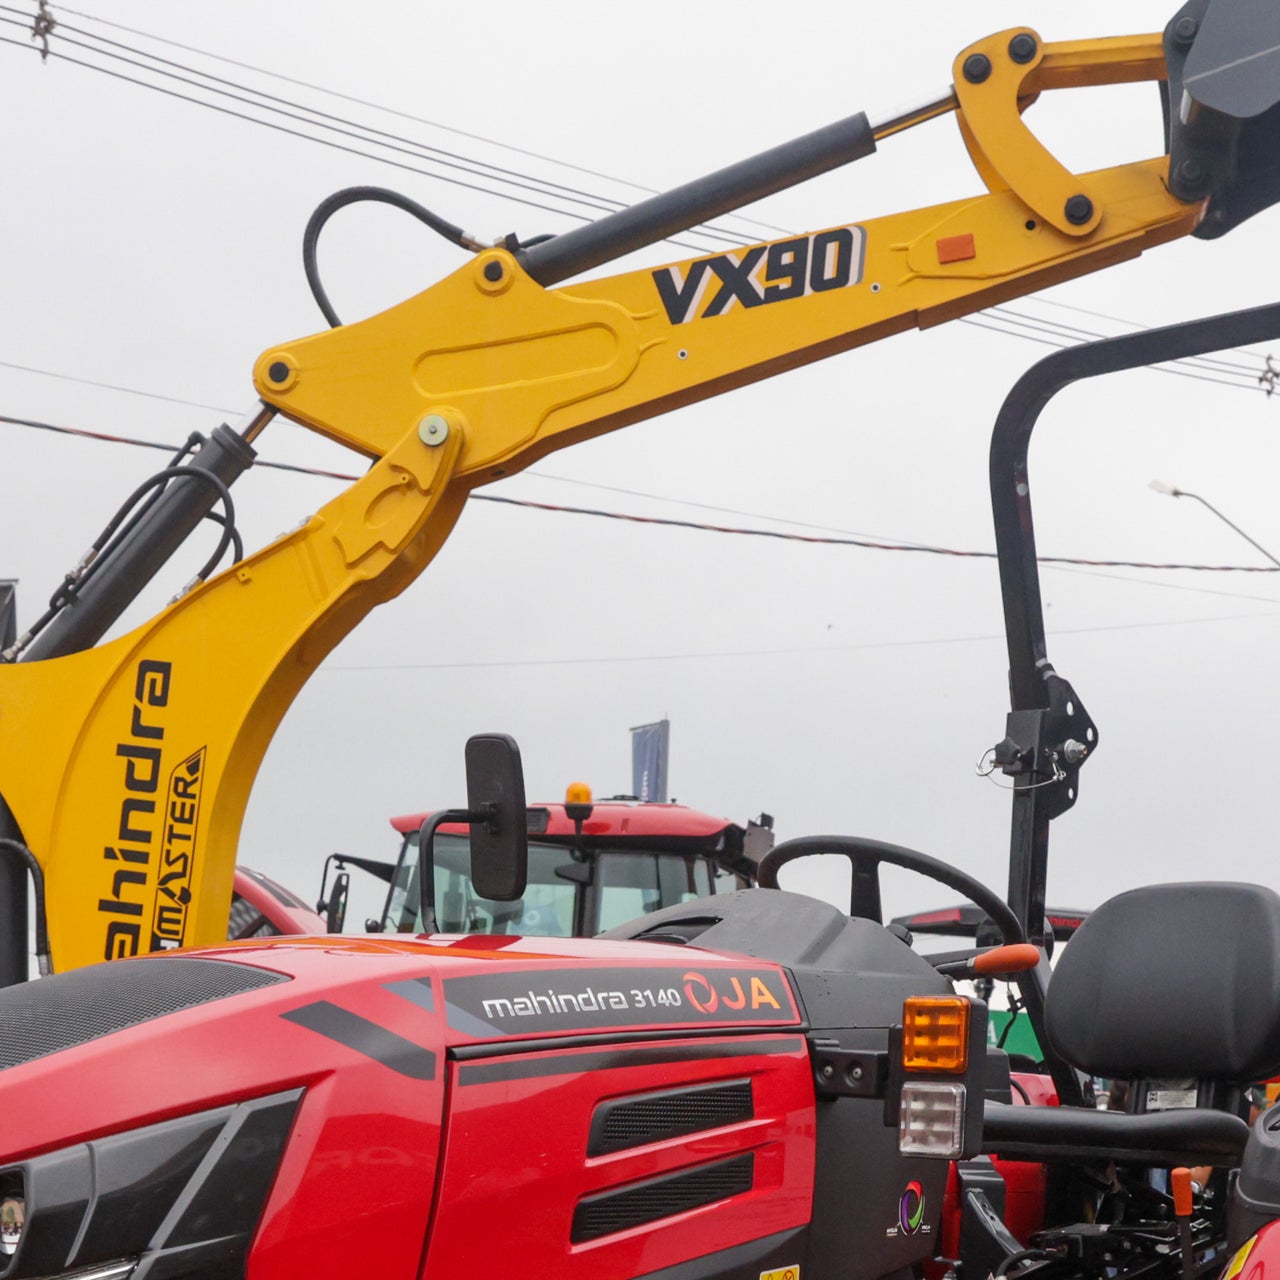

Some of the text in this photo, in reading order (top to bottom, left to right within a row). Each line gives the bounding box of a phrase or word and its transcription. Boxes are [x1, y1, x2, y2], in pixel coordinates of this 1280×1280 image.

[651, 225, 867, 325] VX90
[98, 659, 172, 961] ahindra
[482, 987, 629, 1019] mahindra
[630, 988, 682, 1008] 3140
